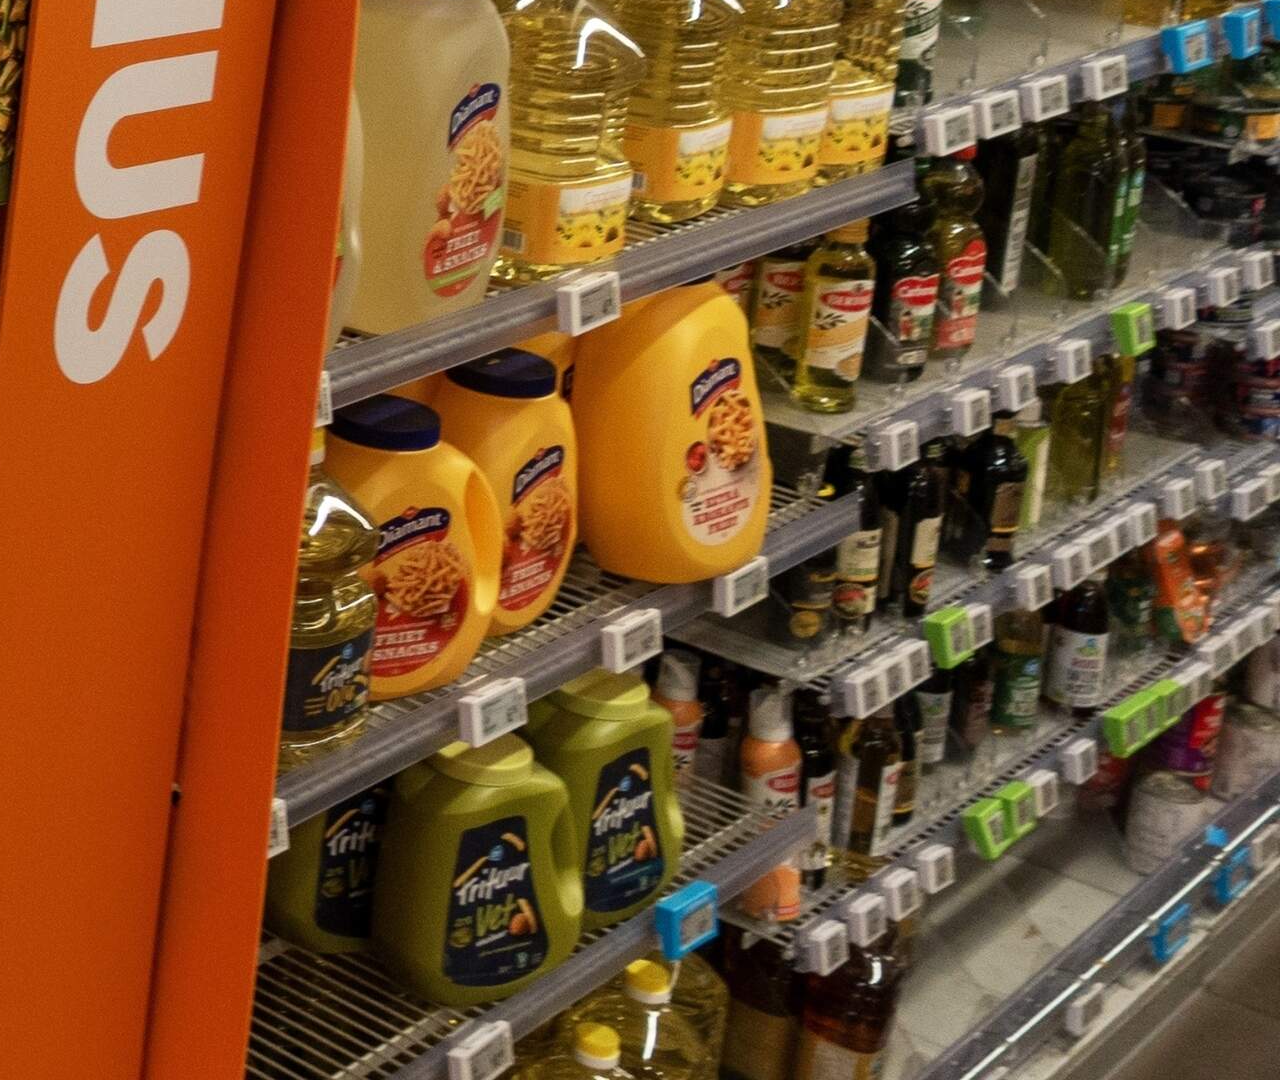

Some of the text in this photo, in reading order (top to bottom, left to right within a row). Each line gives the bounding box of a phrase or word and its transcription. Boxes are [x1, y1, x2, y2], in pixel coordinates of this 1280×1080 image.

[380, 514, 445, 546] Diamant
[373, 641, 439, 663] SNACKS
[375, 628, 427, 648] FRIET
[593, 792, 651, 834] Frituur
[609, 828, 641, 863] Vet
[456, 861, 530, 907] Frituur
[477, 902, 517, 936] Vet
